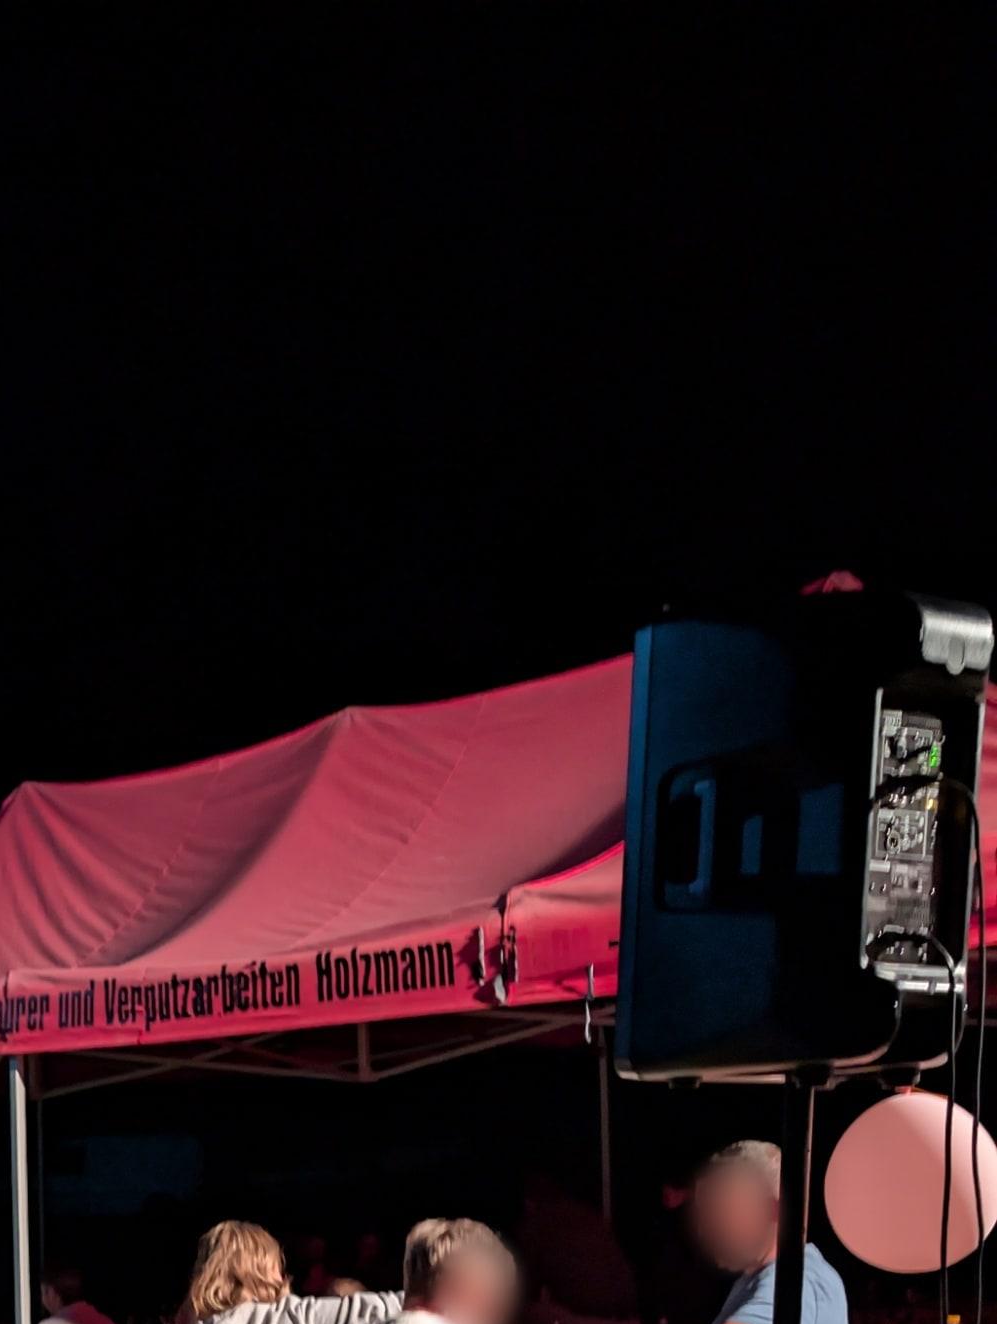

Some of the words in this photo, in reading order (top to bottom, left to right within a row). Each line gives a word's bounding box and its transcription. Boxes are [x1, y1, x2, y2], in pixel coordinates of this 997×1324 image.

[59, 980, 95, 1028] und
[104, 961, 301, 1032] Verputzarbeiten
[315, 940, 455, 1002] Holzmann
